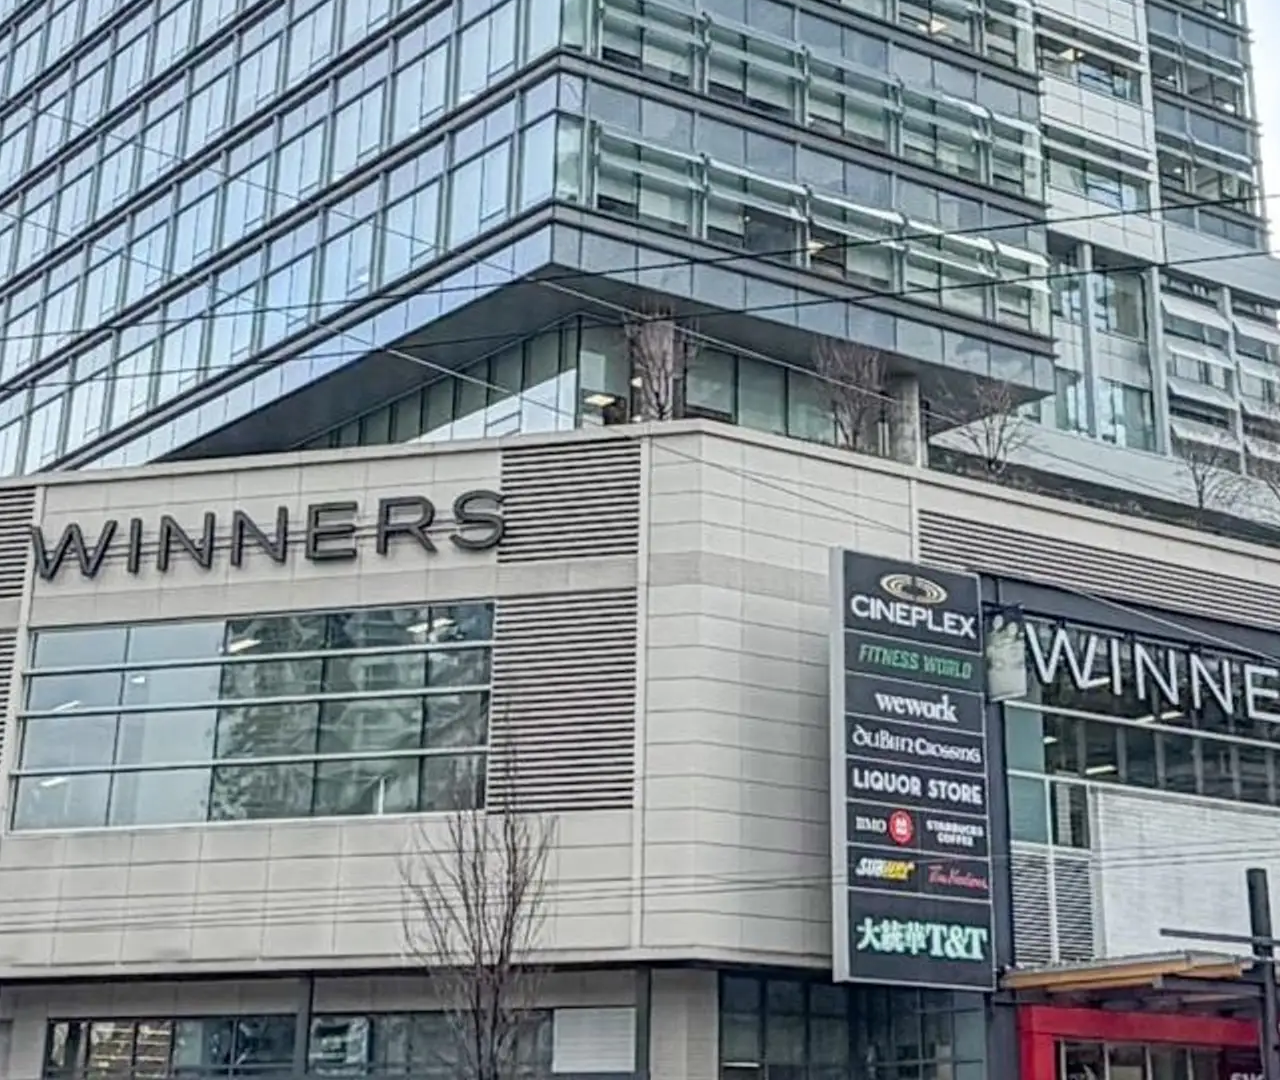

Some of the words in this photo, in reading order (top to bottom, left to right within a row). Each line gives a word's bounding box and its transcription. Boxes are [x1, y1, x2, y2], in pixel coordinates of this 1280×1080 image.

[31, 490, 505, 581] WINNERS
[851, 594, 977, 639] CINEPLEX
[859, 644, 920, 670] FITNESS
[923, 655, 973, 679] WORLD
[853, 767, 922, 797] LIQUOR
[928, 778, 983, 805] STORE
